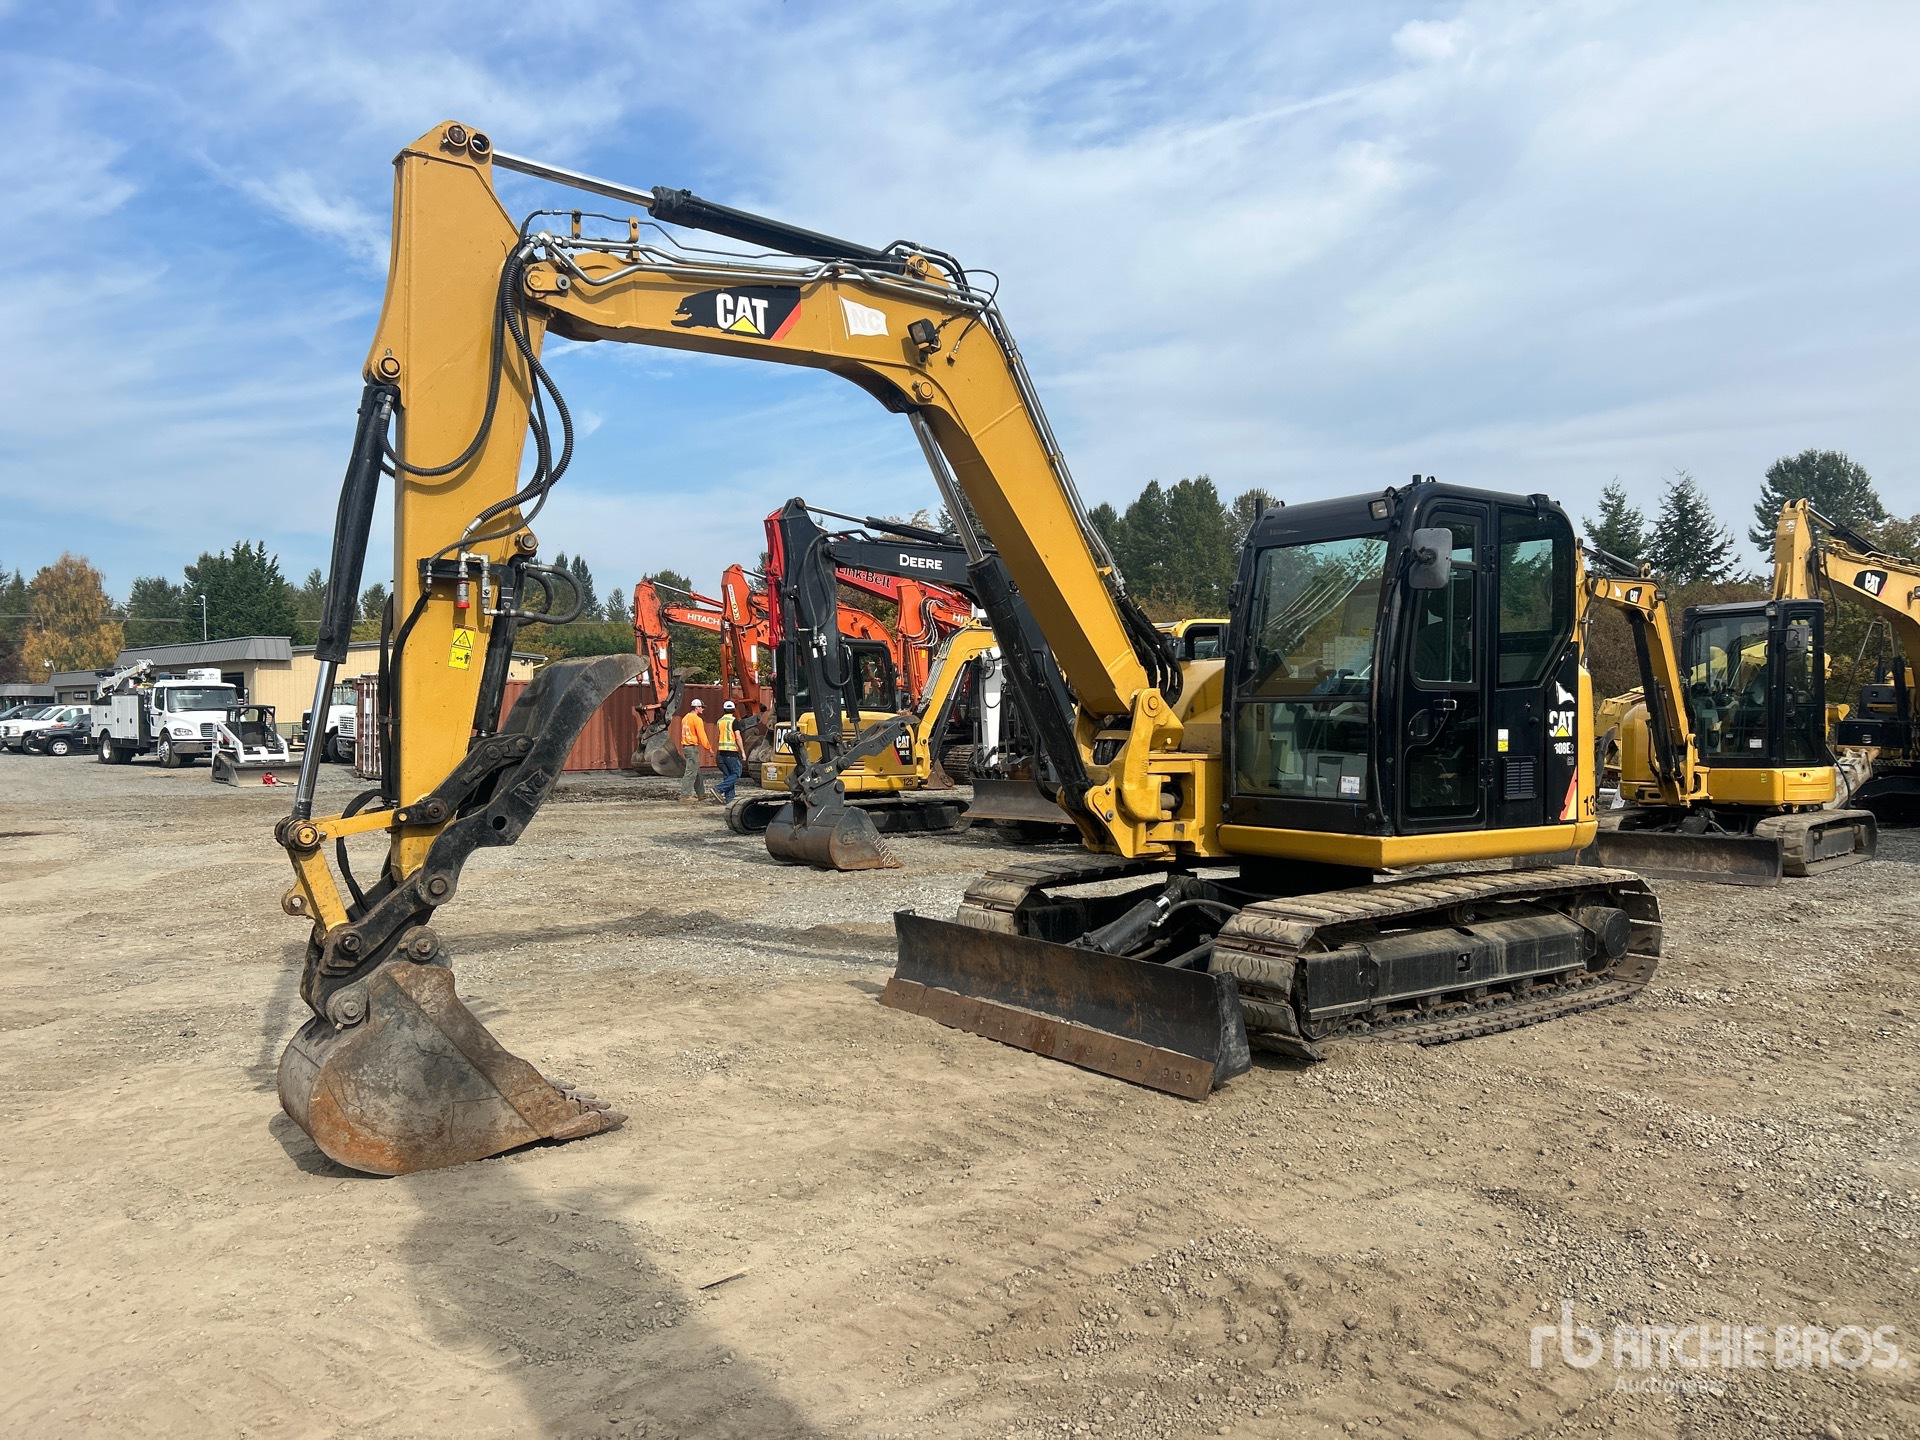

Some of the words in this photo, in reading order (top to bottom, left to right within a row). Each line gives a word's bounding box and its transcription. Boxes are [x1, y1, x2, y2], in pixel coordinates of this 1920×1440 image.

[716, 293, 769, 335] CAT
[852, 310, 882, 331] NC
[899, 553, 943, 571] DEERE
[836, 567, 892, 589] Link-Belt
[1864, 571, 1881, 594] CAT
[687, 612, 721, 626] HITACH
[1549, 710, 1575, 737] CAT
[896, 735, 910, 748] CAT
[903, 778, 913, 786] 125
